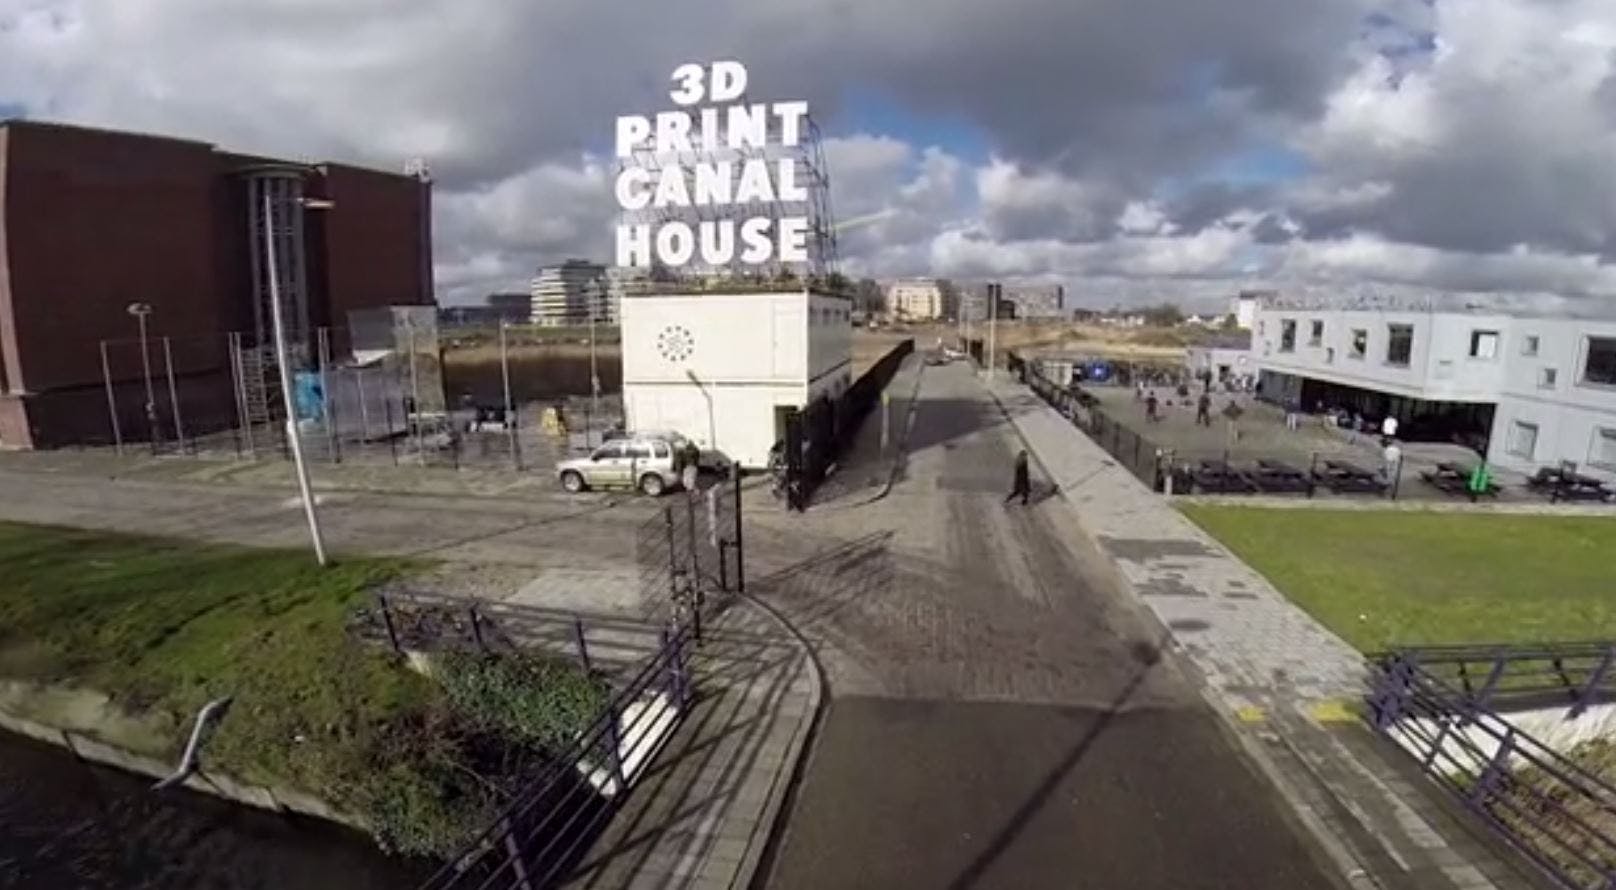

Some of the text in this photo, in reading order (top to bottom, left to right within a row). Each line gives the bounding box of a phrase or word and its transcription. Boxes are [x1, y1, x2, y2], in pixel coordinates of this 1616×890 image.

[669, 60, 748, 105] 3D
[616, 100, 808, 157] PRINT
[615, 158, 808, 210] CANAL
[616, 216, 808, 267] HOUSE
